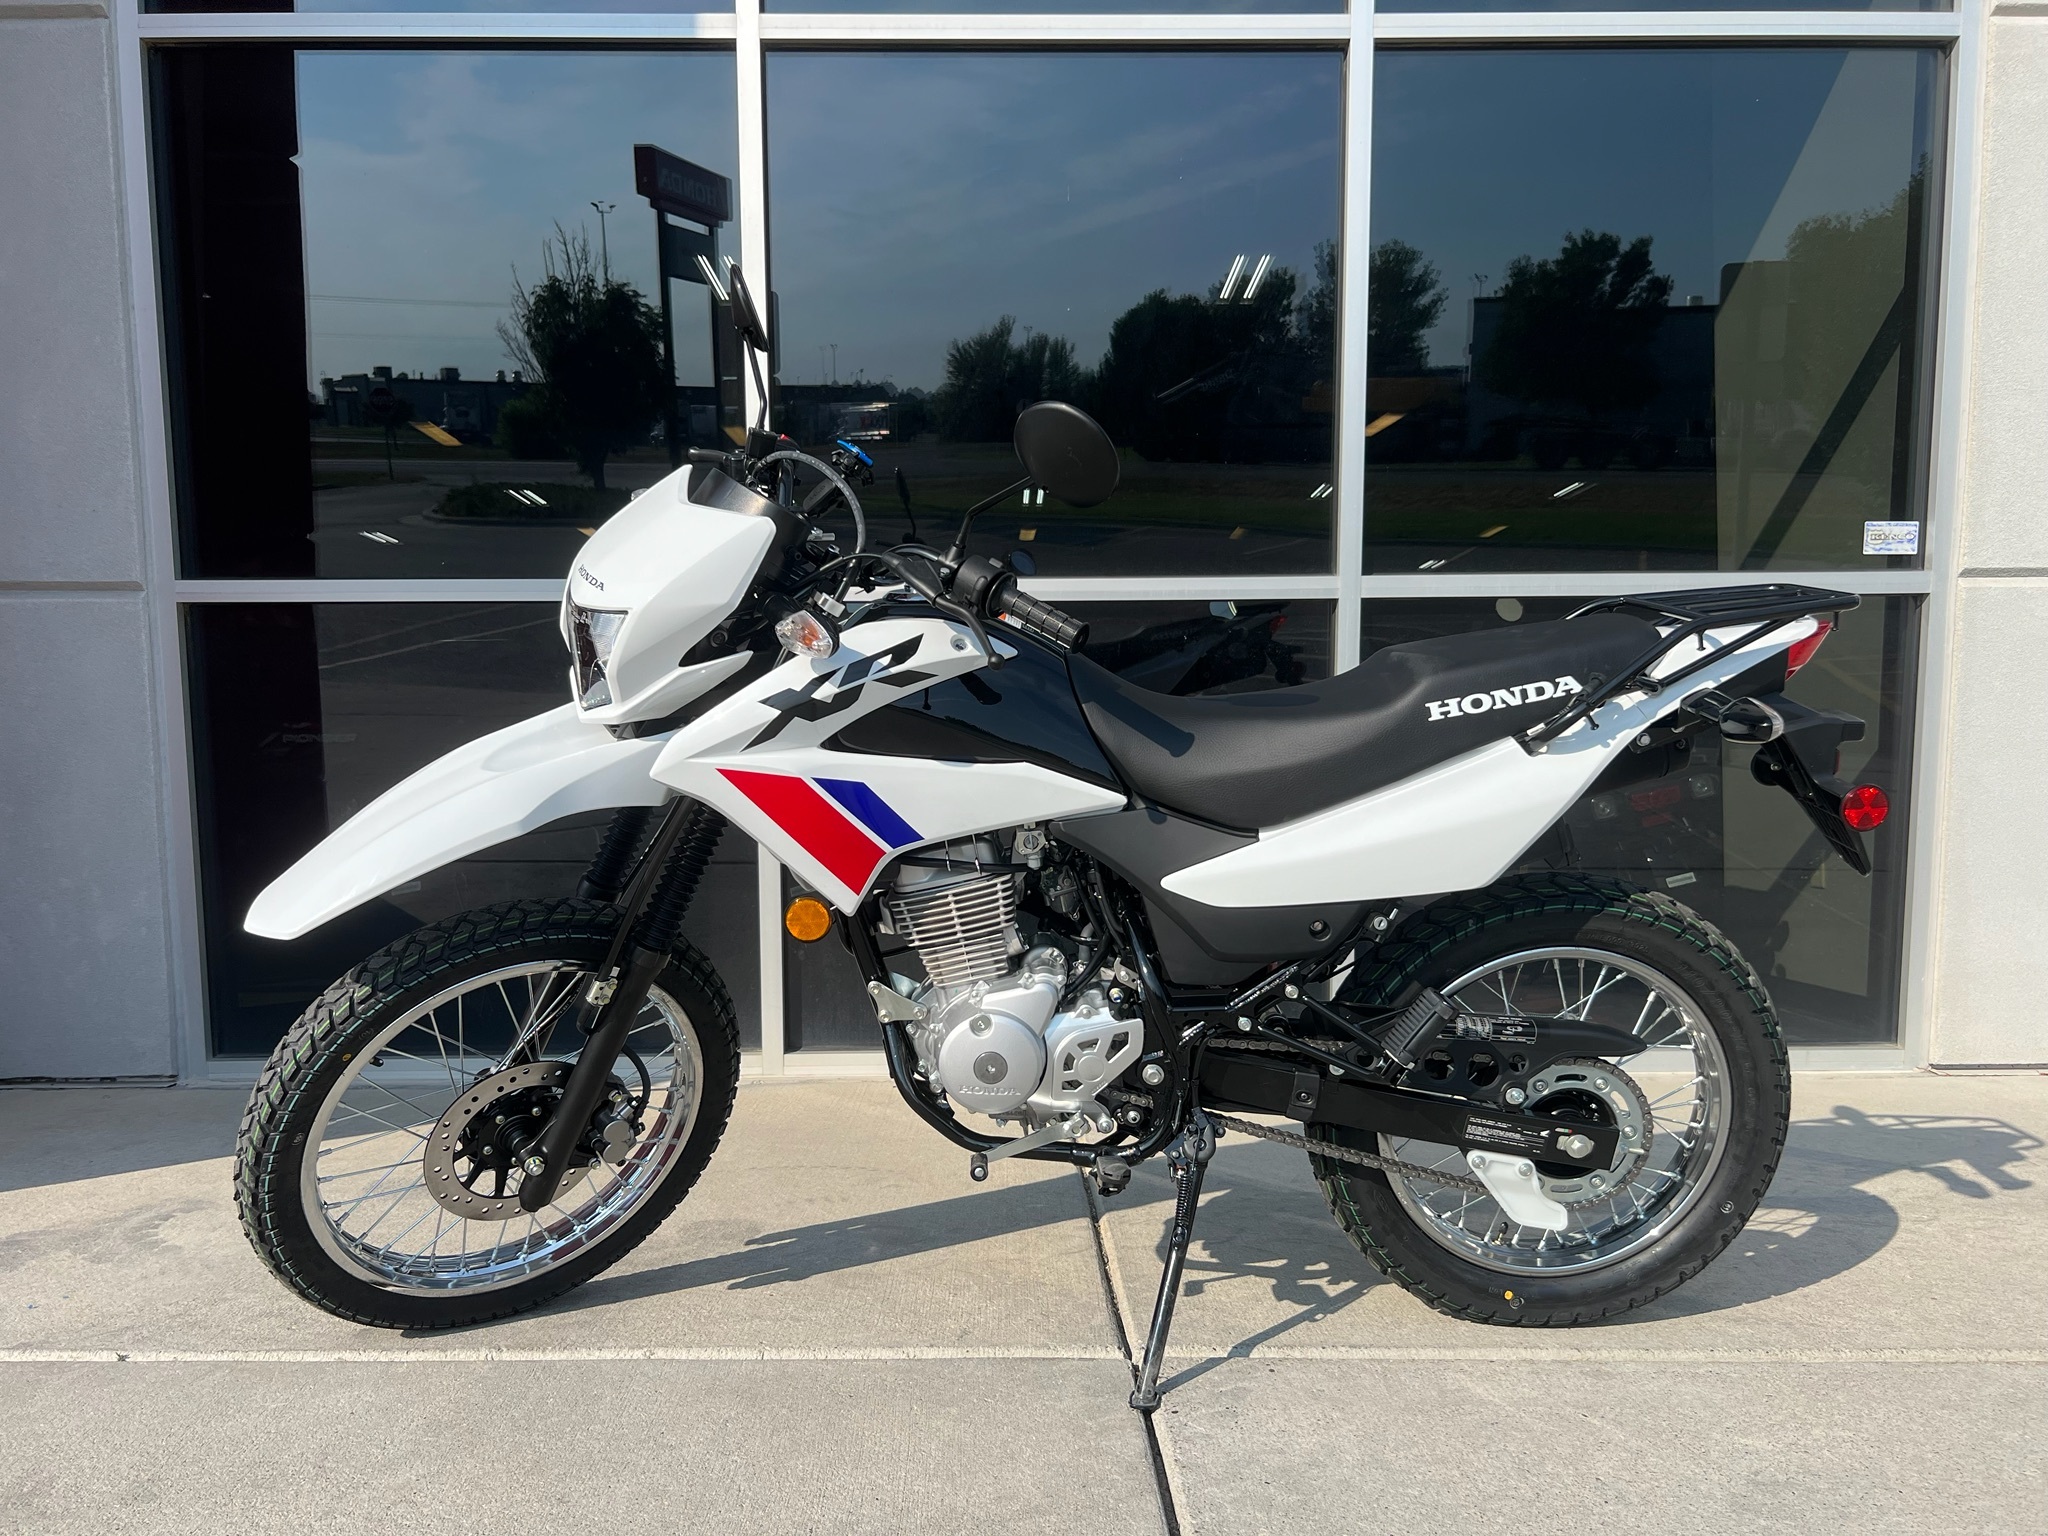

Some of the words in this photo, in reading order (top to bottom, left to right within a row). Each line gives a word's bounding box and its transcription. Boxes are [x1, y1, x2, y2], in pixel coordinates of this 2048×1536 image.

[578, 564, 604, 591] HONDA
[1425, 675, 1584, 721] HONDA
[959, 1085, 1021, 1095] HONDA
